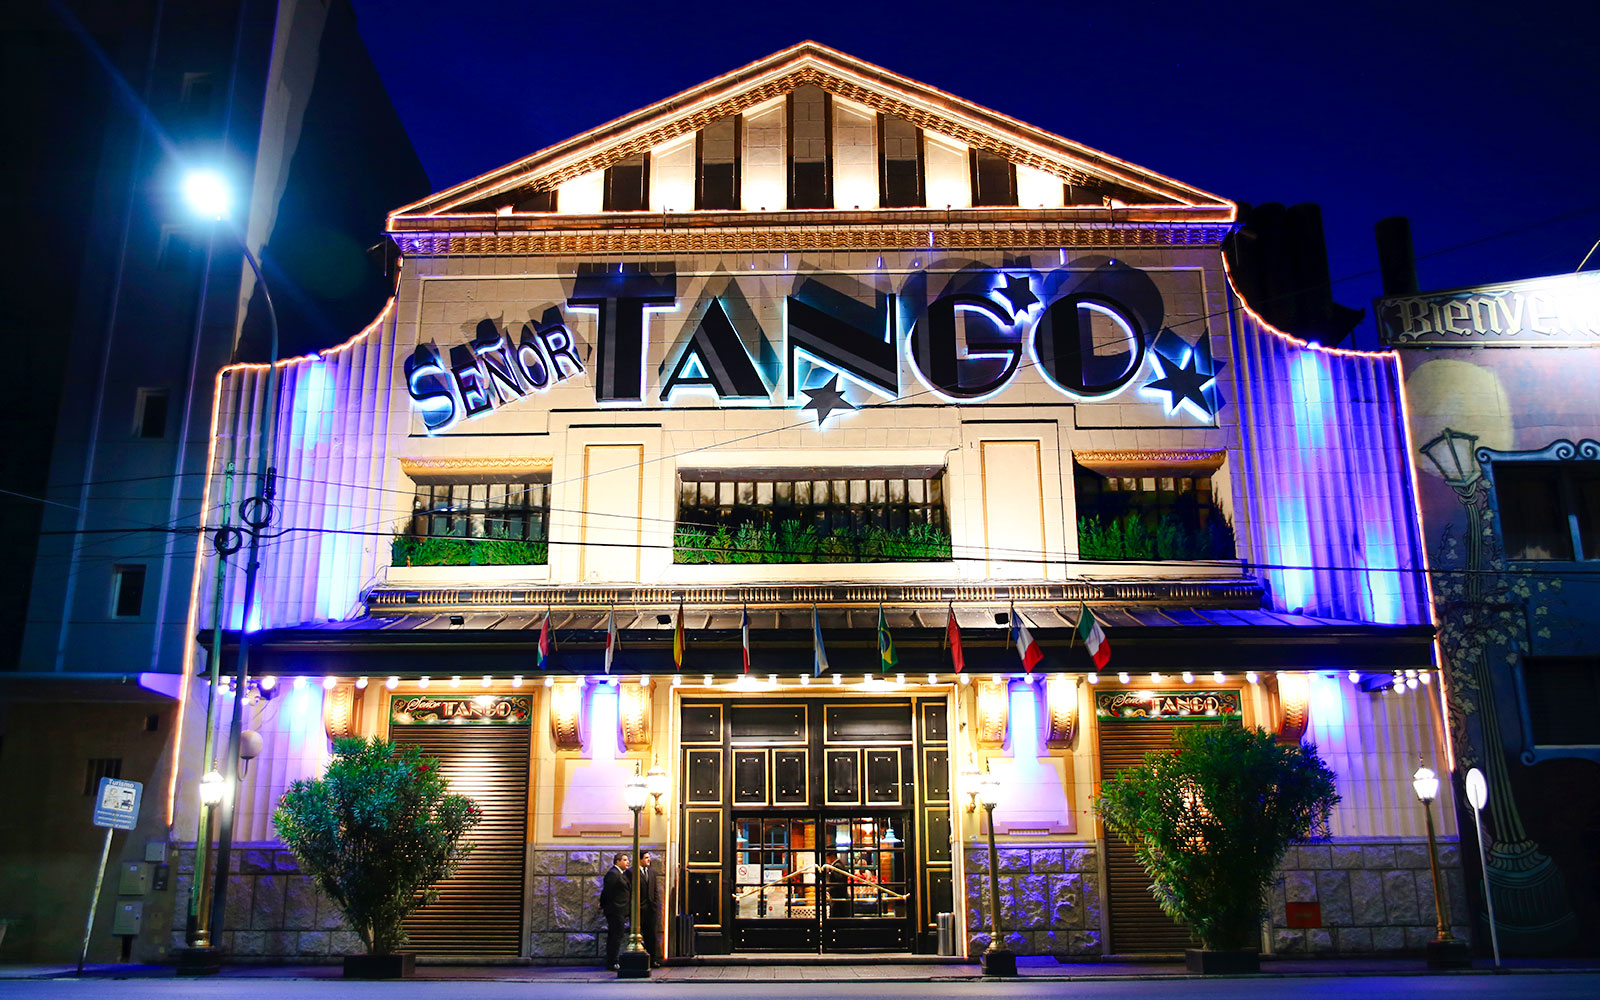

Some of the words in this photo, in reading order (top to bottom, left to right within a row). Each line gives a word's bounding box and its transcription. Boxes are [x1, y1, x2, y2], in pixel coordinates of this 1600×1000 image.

[406, 324, 585, 433] SEÑOR
[565, 292, 1146, 406] TANGO
[442, 701, 512, 718] TANGO
[1149, 696, 1219, 714] TANGO
[109, 779, 134, 788] Turismo
